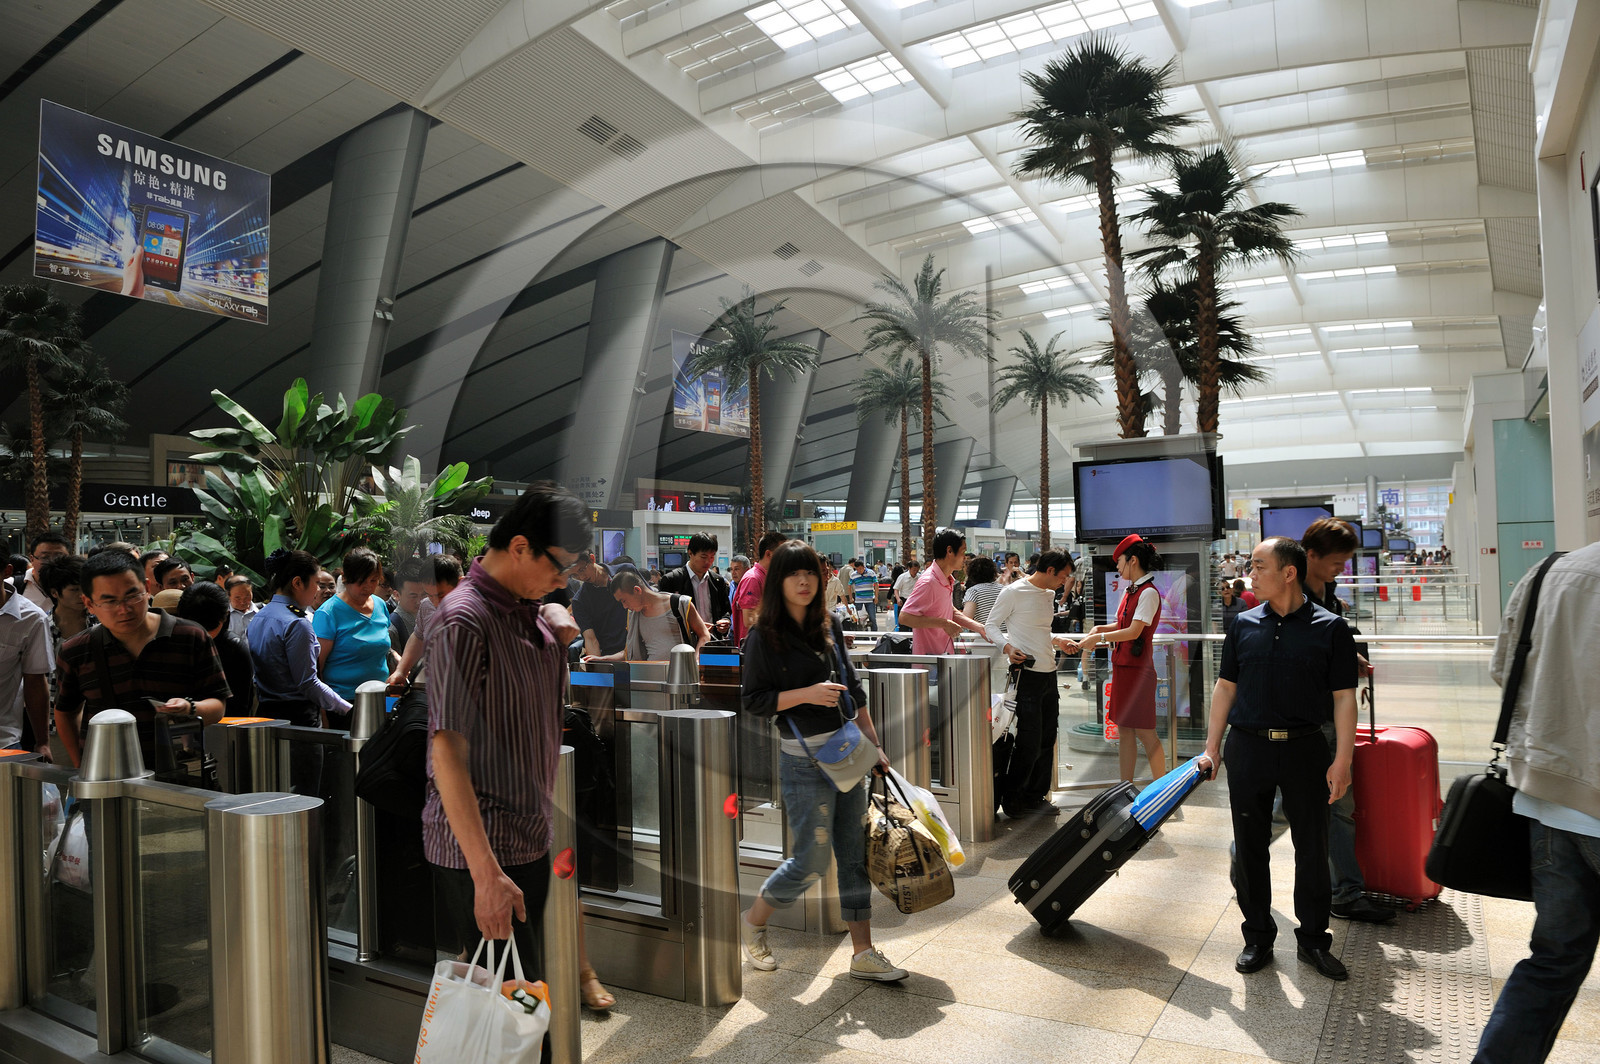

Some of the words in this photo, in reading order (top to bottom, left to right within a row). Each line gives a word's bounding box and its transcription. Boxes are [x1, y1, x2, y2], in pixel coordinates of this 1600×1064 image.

[97, 133, 227, 191] SAMSUNG
[208, 298, 240, 312] GALAXY
[241, 305, 259, 314] Tab
[103, 492, 167, 508] Gentle
[470, 507, 491, 519] Jeep
